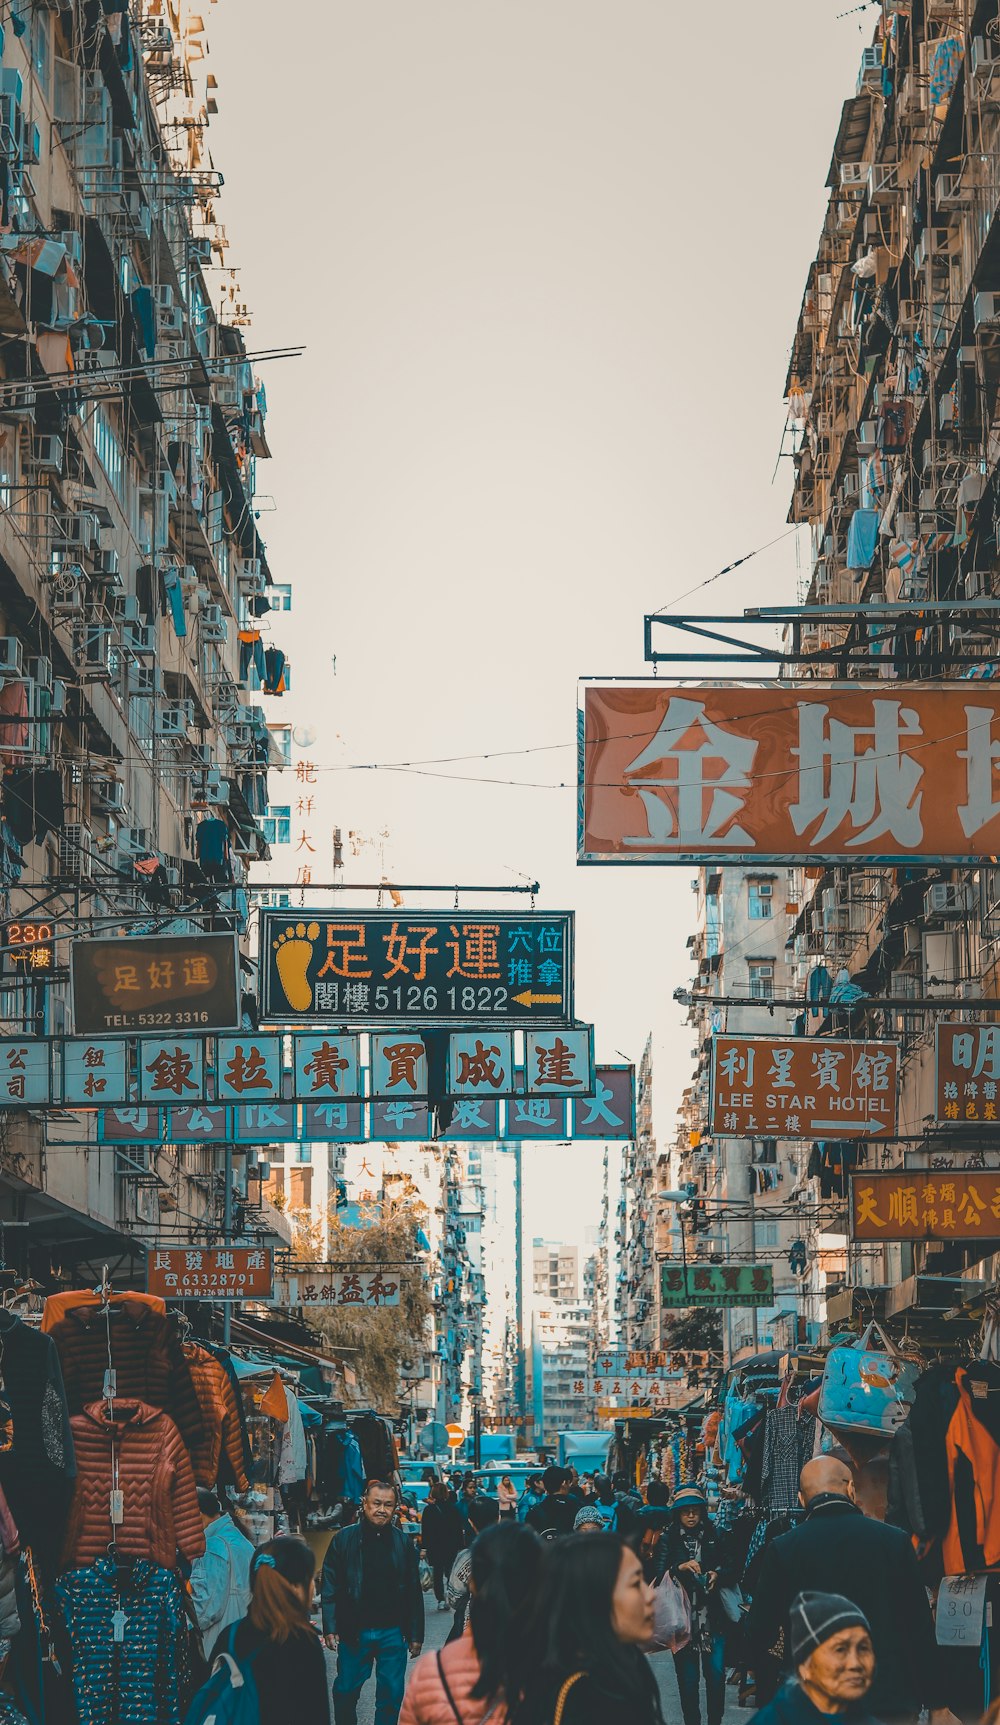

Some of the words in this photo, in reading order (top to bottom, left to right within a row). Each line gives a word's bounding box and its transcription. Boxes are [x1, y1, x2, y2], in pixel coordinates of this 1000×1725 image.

[9, 925, 51, 943] 230
[507, 926, 562, 952] 穴位
[316, 922, 501, 981] 足好運
[114, 957, 210, 992] 足好運
[507, 958, 562, 986] 推拿
[314, 982, 370, 1012] 閣樓
[375, 986, 438, 1011] 5126
[447, 986, 507, 1011] 1822
[104, 1015, 135, 1027] TEL:
[138, 1013, 171, 1025] 5322
[175, 1011, 208, 1023] 3316
[719, 1092, 754, 1107] LEE
[766, 1094, 816, 1110] STAR
[829, 1096, 891, 1112] HOTEL
[944, 1101, 998, 1121] 特色菜
[723, 1112, 802, 1133] 請上二樓
[154, 1251, 267, 1271] 長發地產
[182, 1273, 255, 1287] 63328791
[948, 1601, 973, 1617] 30
[951, 1624, 966, 1640] 元
